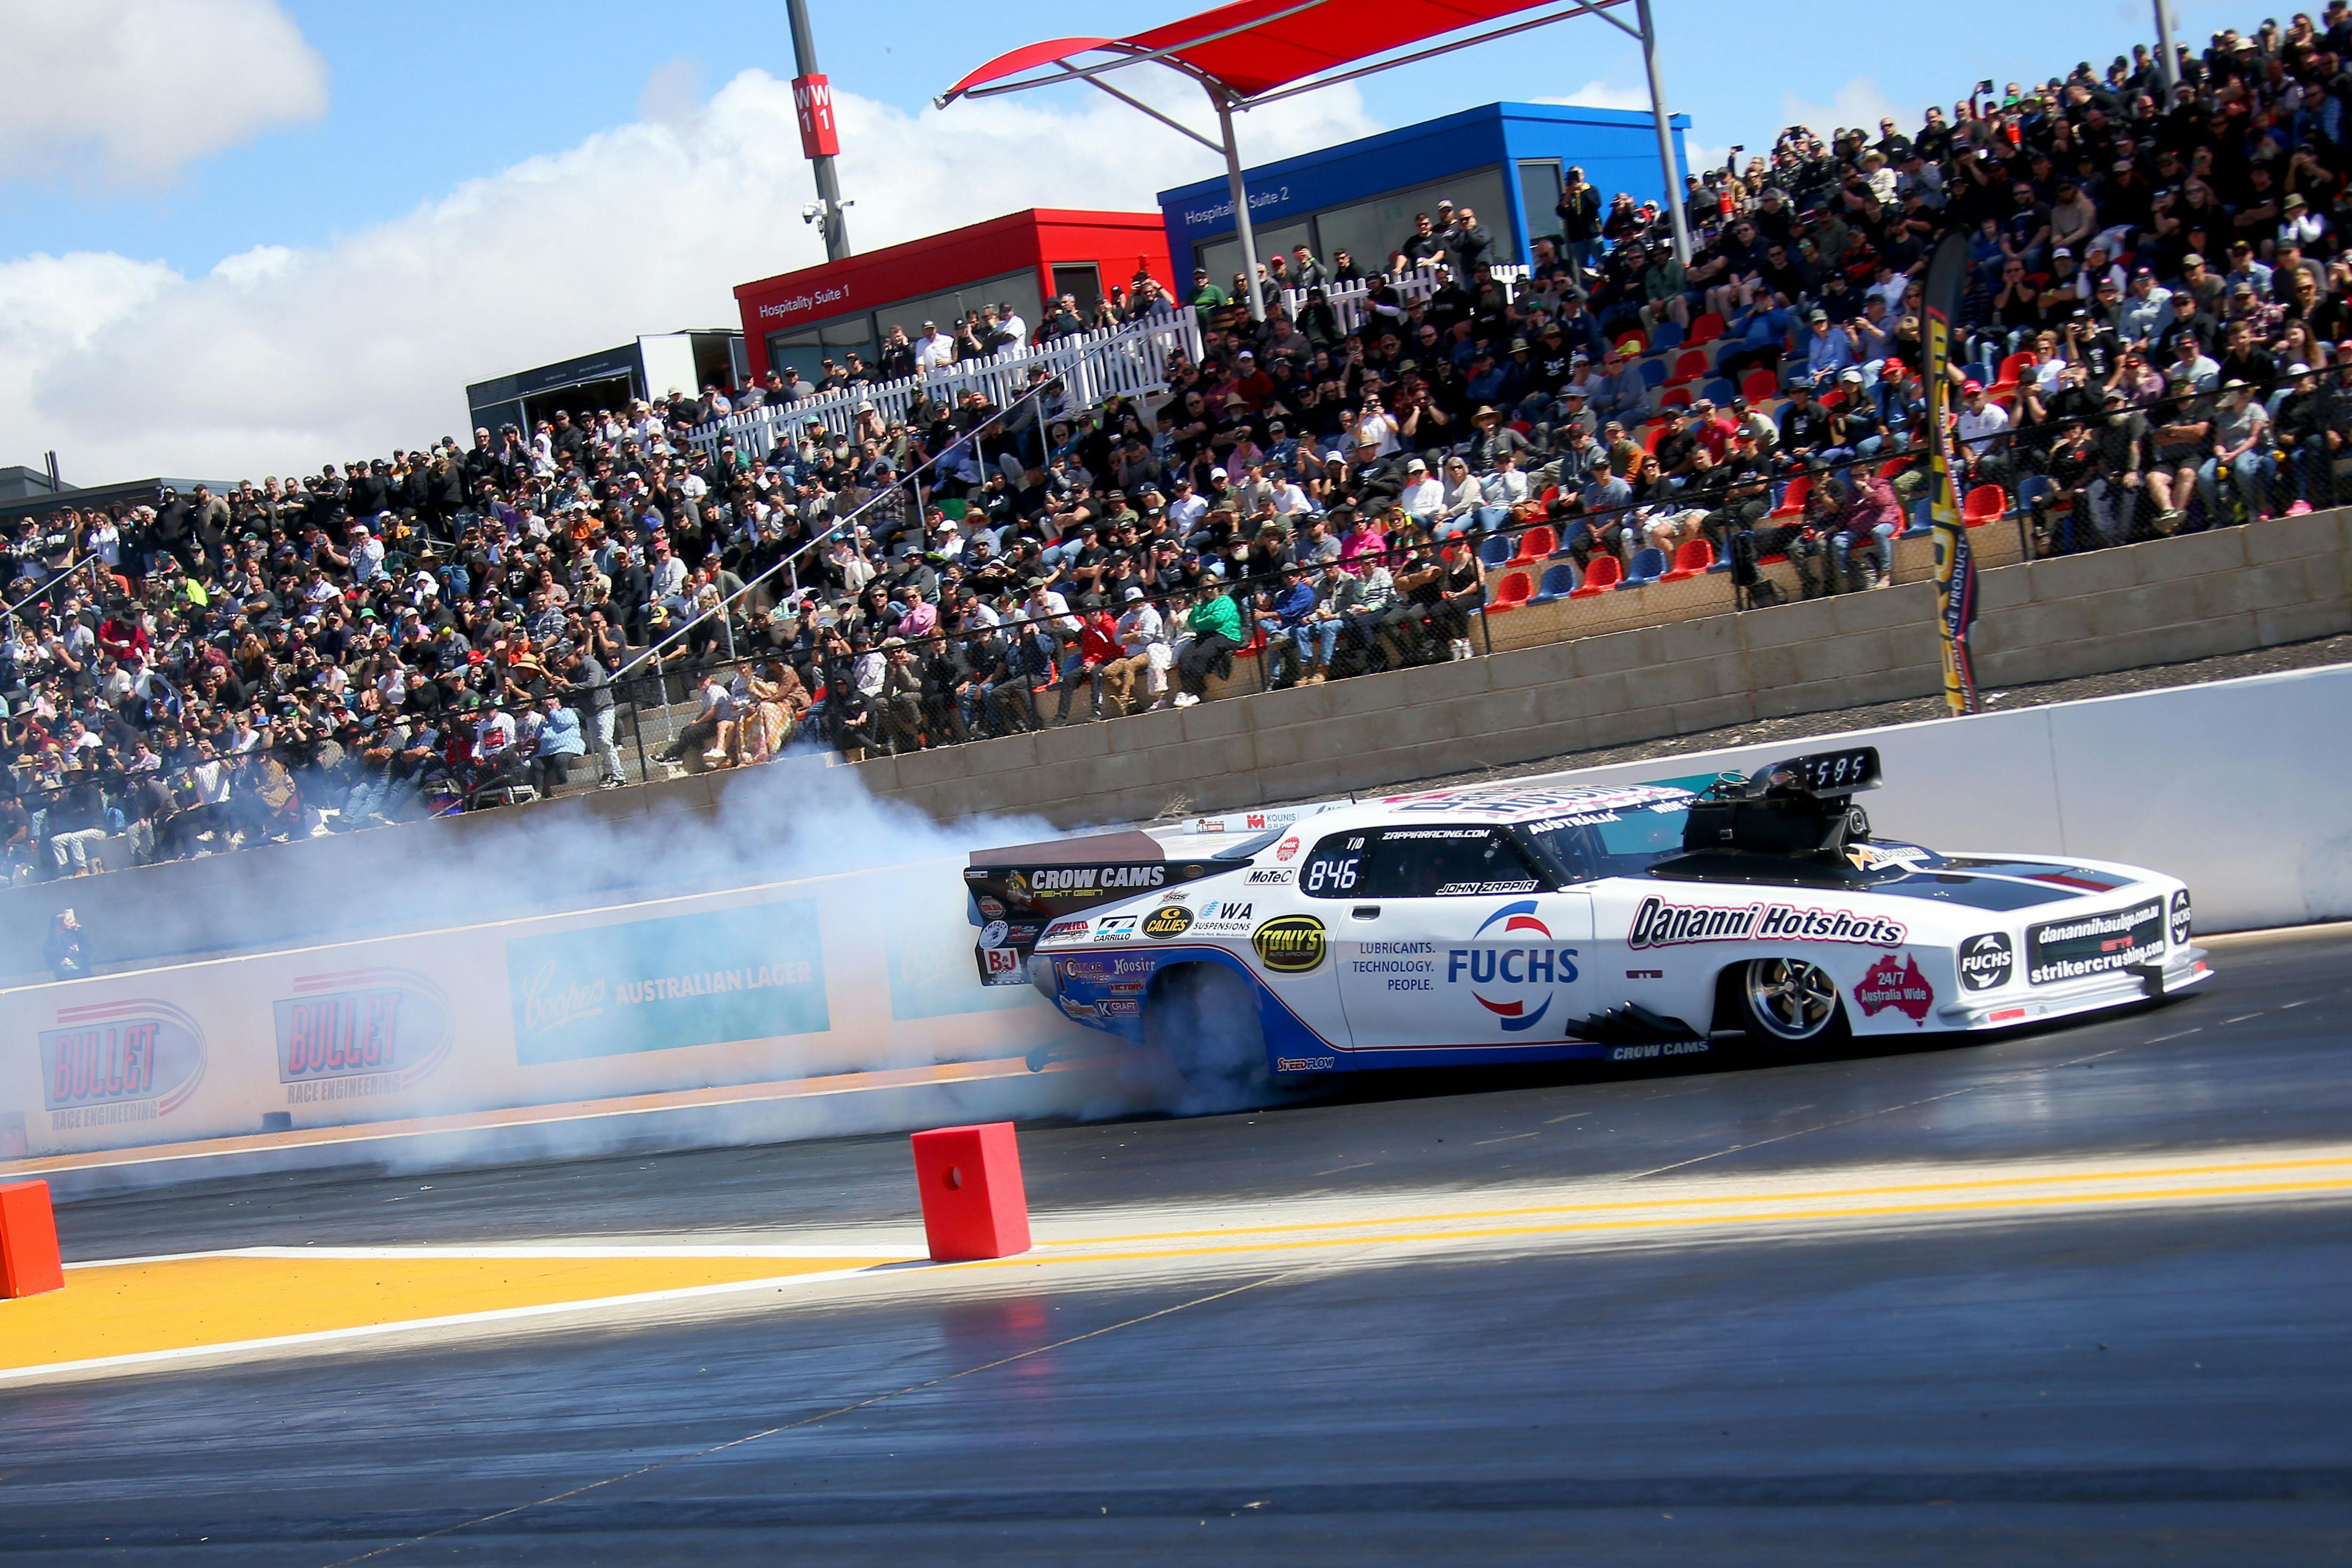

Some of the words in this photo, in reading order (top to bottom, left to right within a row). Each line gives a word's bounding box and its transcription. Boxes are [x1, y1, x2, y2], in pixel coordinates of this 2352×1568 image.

[810, 84, 828, 106] W
[819, 108, 830, 130] 1
[1248, 192, 1279, 209] Suite
[1280, 186, 1289, 200] 2
[759, 295, 813, 318] Hospitality
[815, 289, 841, 304] Suite
[843, 284, 849, 296] 1
[1528, 812, 1622, 835] AUSTRALIA
[1648, 801, 1688, 813] WIDE
[1382, 829, 1490, 840] ZAPPIARACING.COM
[1032, 869, 1097, 889] CROW
[1100, 866, 1165, 887] CAMS
[1249, 870, 1292, 883] MoTeC
[1308, 859, 1359, 890] 846
[1435, 882, 1480, 895] JOHN
[1478, 880, 1539, 894] ZAPPIA
[985, 922, 1007, 932] IMPACT
[1146, 919, 1188, 932] CALLIES
[1631, 898, 1758, 944] Dananni
[1760, 907, 1902, 942] Hotshots
[2172, 907, 2191, 927] FUCHS
[1094, 933, 1131, 942] CARRILLO
[1262, 929, 1325, 951] TONY'S
[1360, 942, 1435, 954] LUBRICANTS.
[988, 950, 1016, 971] B&J
[1070, 962, 1103, 973] TAYLOR
[1113, 957, 1155, 975] Hoosier
[1352, 961, 1434, 972] TECHNOLOGY.
[1448, 949, 1579, 983] FUCHS
[1962, 951, 2011, 972] FUCHS
[2031, 940, 2164, 983] strikercrushing.com
[615, 970, 742, 1005] AUSTRALIAN
[746, 961, 812, 990] LAGER
[1081, 973, 1110, 984] TYRES
[1388, 979, 1434, 990] PEOPLE.
[1877, 972, 1905, 986] 24/7
[522, 960, 605, 1030] Coopers
[1861, 989, 1902, 1003] Australia
[1903, 988, 1927, 1000] Wide
[1098, 1003, 1112, 1016] K
[1112, 1002, 1135, 1011] CRAFT
[289, 993, 403, 1075] BULLET
[1613, 1045, 1660, 1060] CROW
[1663, 1041, 1709, 1055] CAMS
[54, 1023, 160, 1103] BULLET
[288, 1082, 318, 1104] RACE
[321, 1073, 400, 1101] ENGINEERING
[53, 1111, 81, 1131] RACE
[84, 1100, 157, 1128] ENGINEERING
